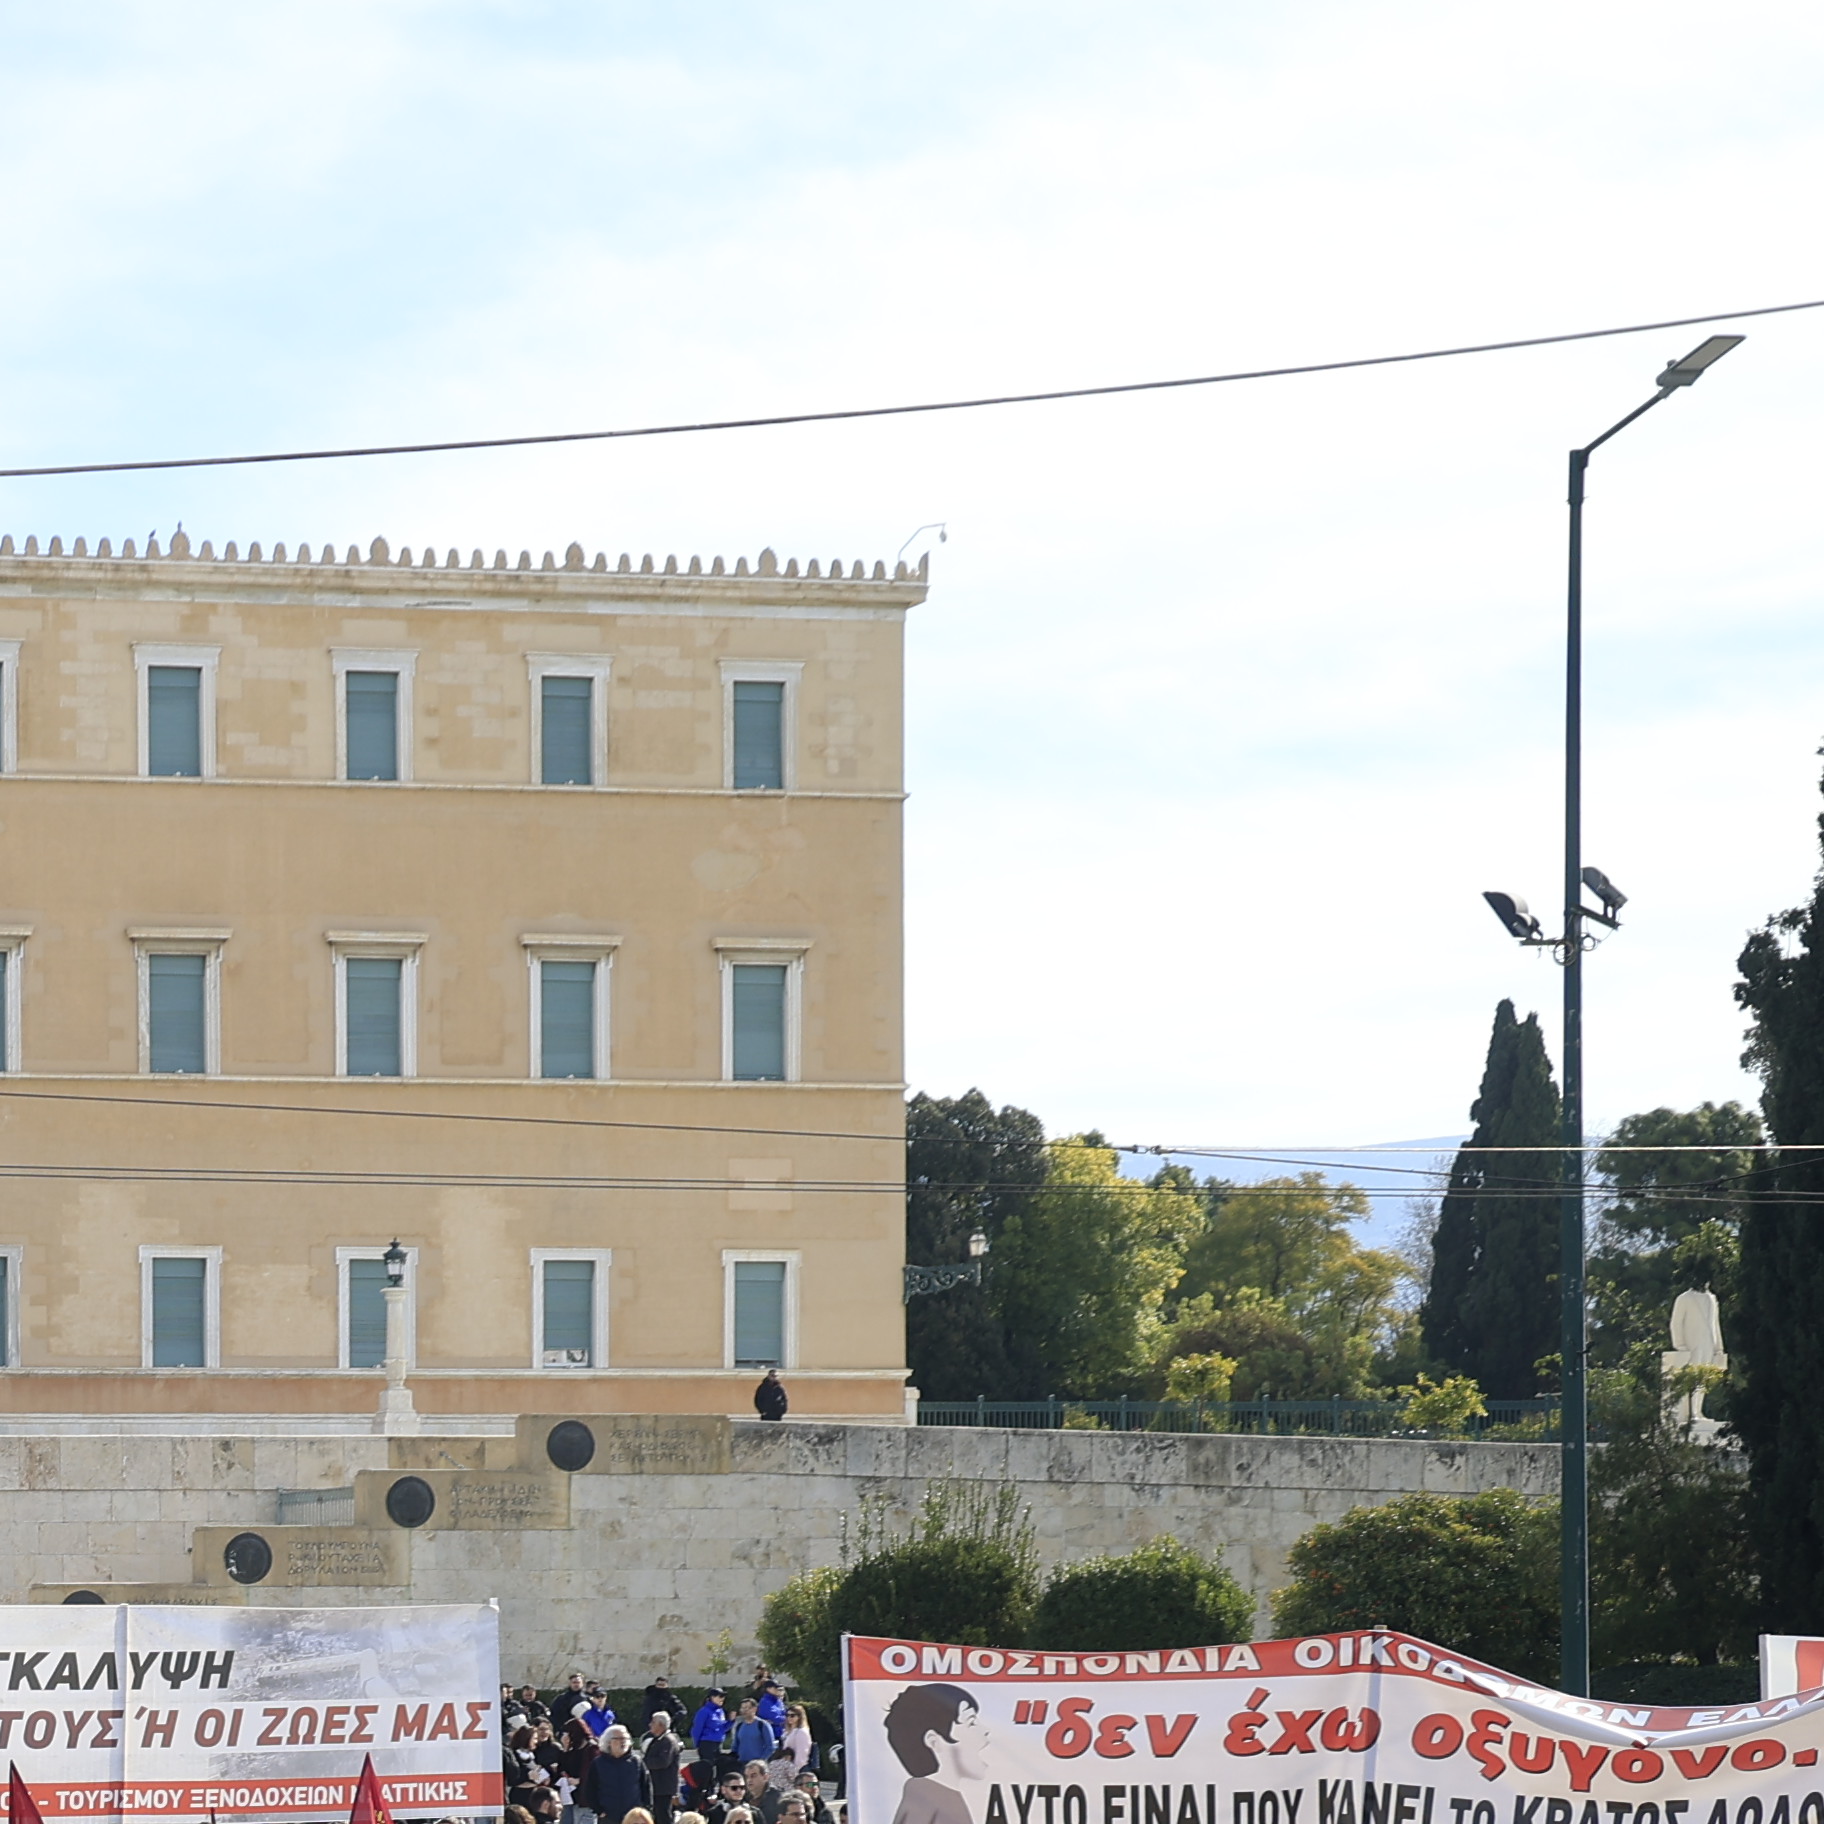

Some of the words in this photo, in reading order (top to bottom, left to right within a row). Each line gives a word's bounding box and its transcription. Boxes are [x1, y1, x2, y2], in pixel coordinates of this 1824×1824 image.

[880, 1641, 1262, 1678] ΟΜΟΣΠΟΝΔΙΑ
[194, 1706, 239, 1747] ΟΙ
[255, 1703, 380, 1747] ΖΩΕΣ
[391, 1701, 493, 1742] ΜΑΣ
[1013, 1695, 1199, 1760] "δεν
[1224, 1687, 1382, 1757] έχω
[55, 1786, 183, 1810] ΤΟΥΡΙΣΜΟΥ
[190, 1785, 343, 1809] ΞΕΝΟΔΟΧΕΙΩΝ
